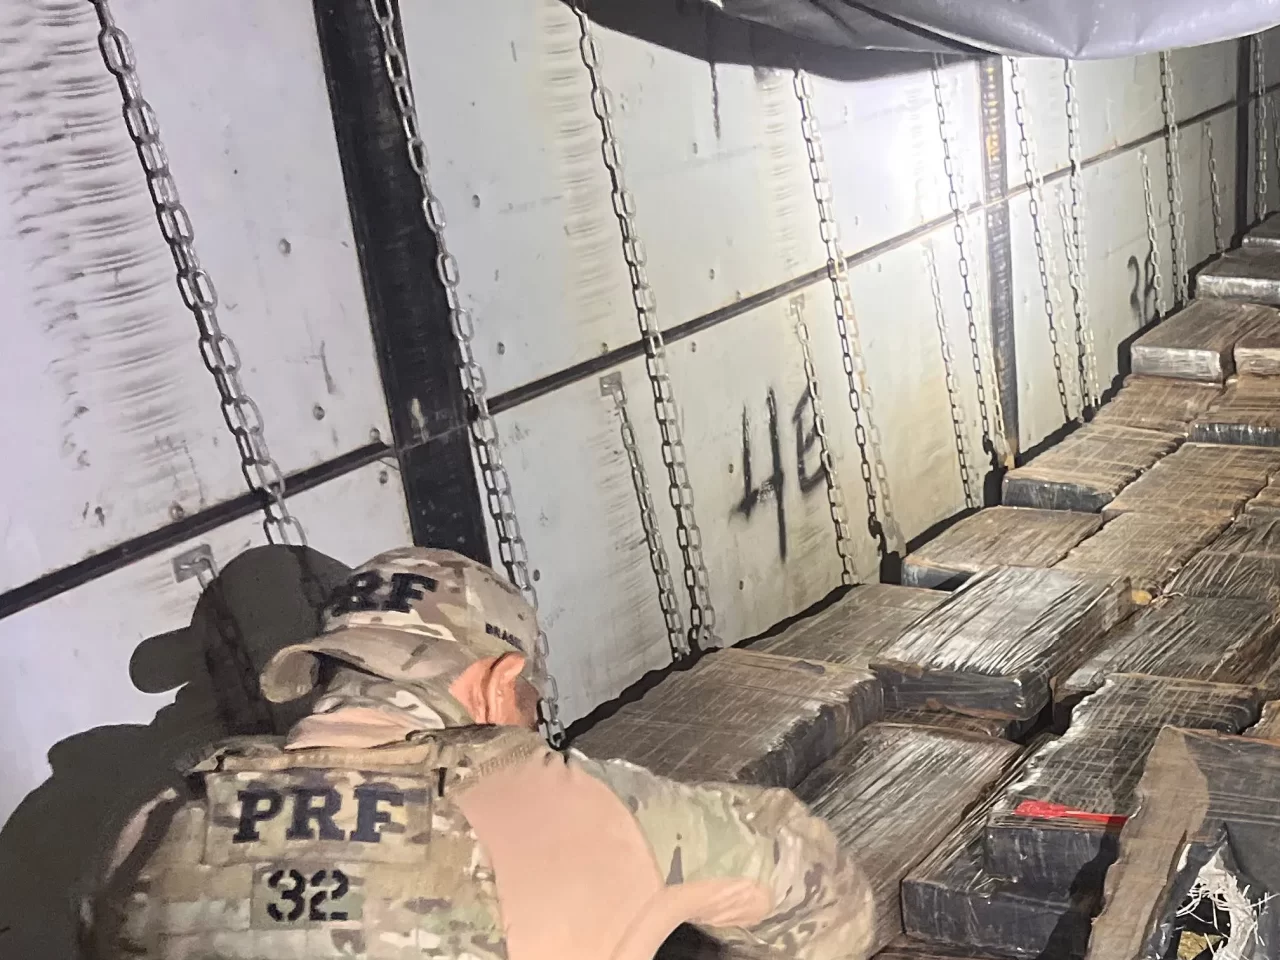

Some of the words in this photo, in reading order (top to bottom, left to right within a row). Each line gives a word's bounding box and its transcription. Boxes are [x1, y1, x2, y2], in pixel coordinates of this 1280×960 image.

[331, 569, 439, 616] RF
[232, 785, 405, 843] PRF
[266, 868, 349, 922] 32
